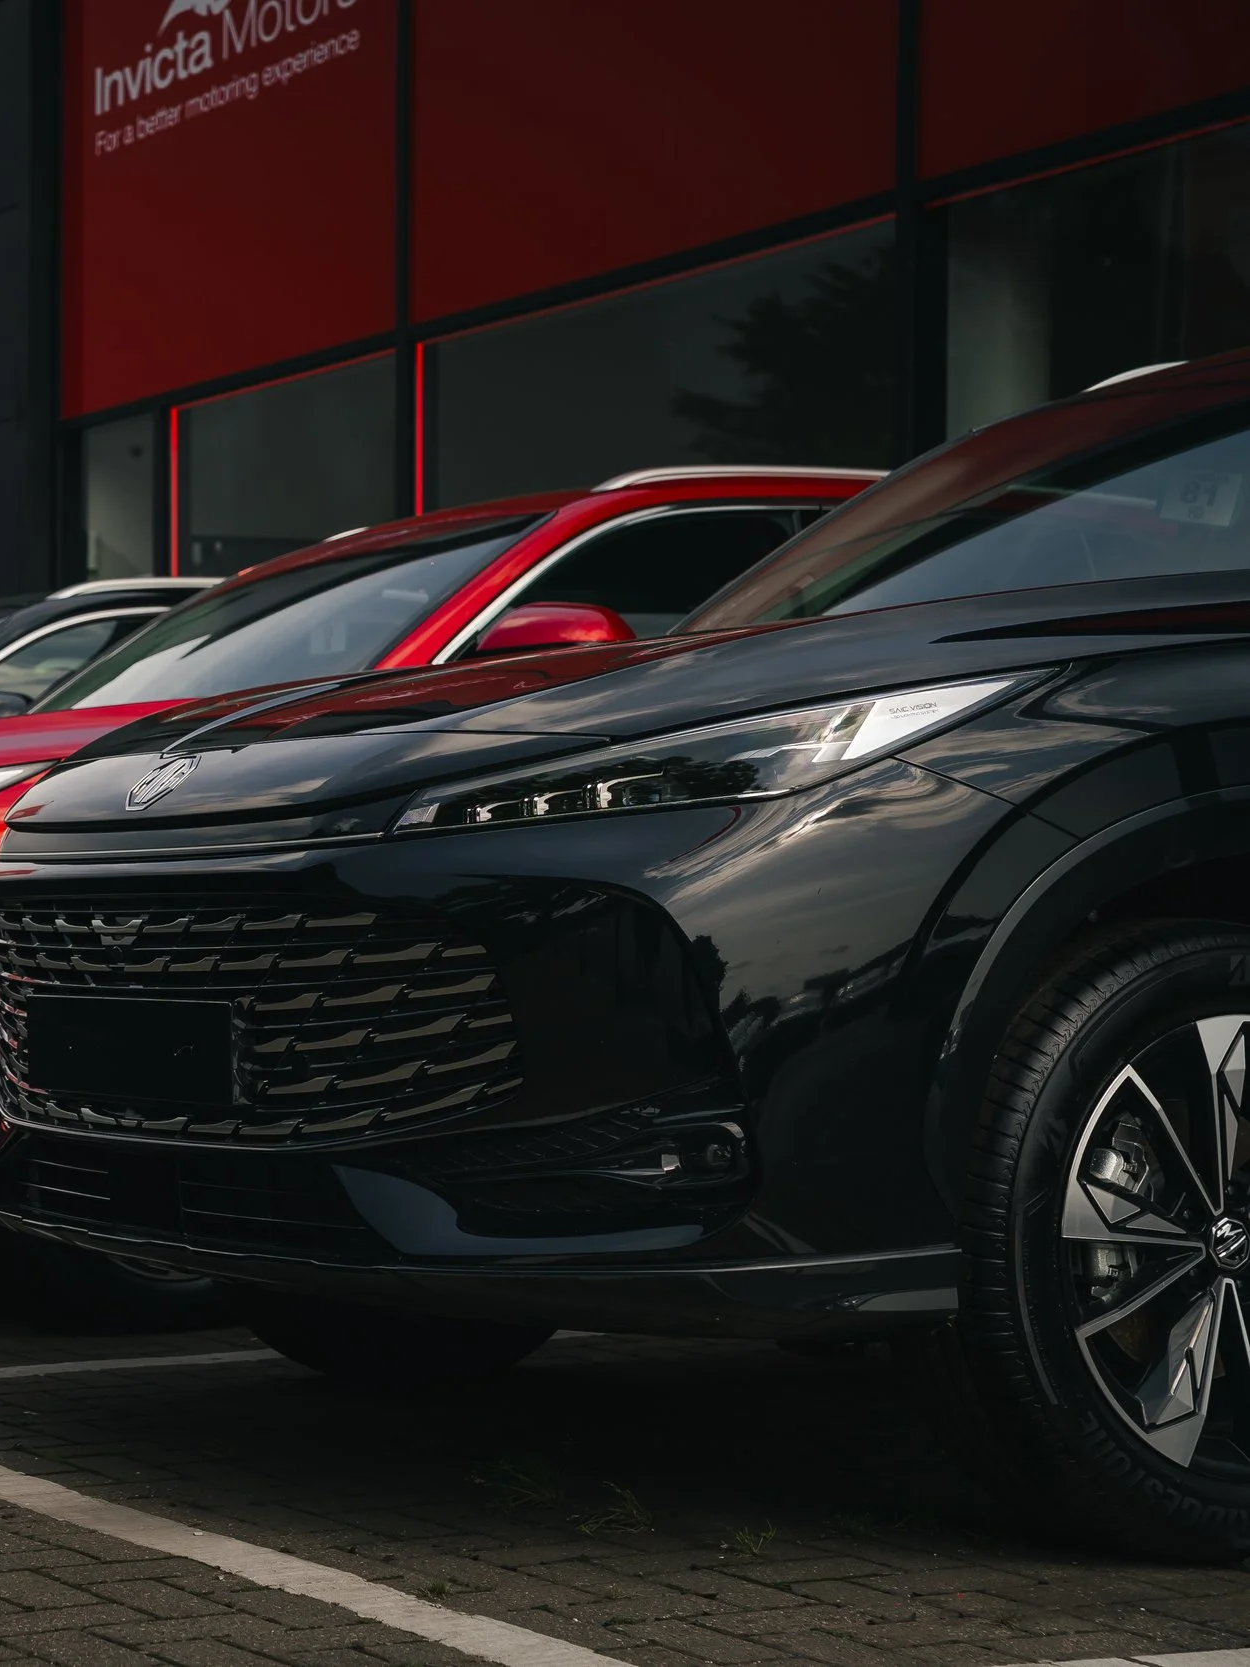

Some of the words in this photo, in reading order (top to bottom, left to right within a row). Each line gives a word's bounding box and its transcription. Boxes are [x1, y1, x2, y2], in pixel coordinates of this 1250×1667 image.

[94, 30, 214, 116] Invicta
[222, 0, 357, 59] Moto
[94, 130, 121, 157] For
[122, 124, 135, 146] a
[136, 104, 182, 139] better
[184, 72, 259, 119] motoring
[261, 29, 361, 86] experience
